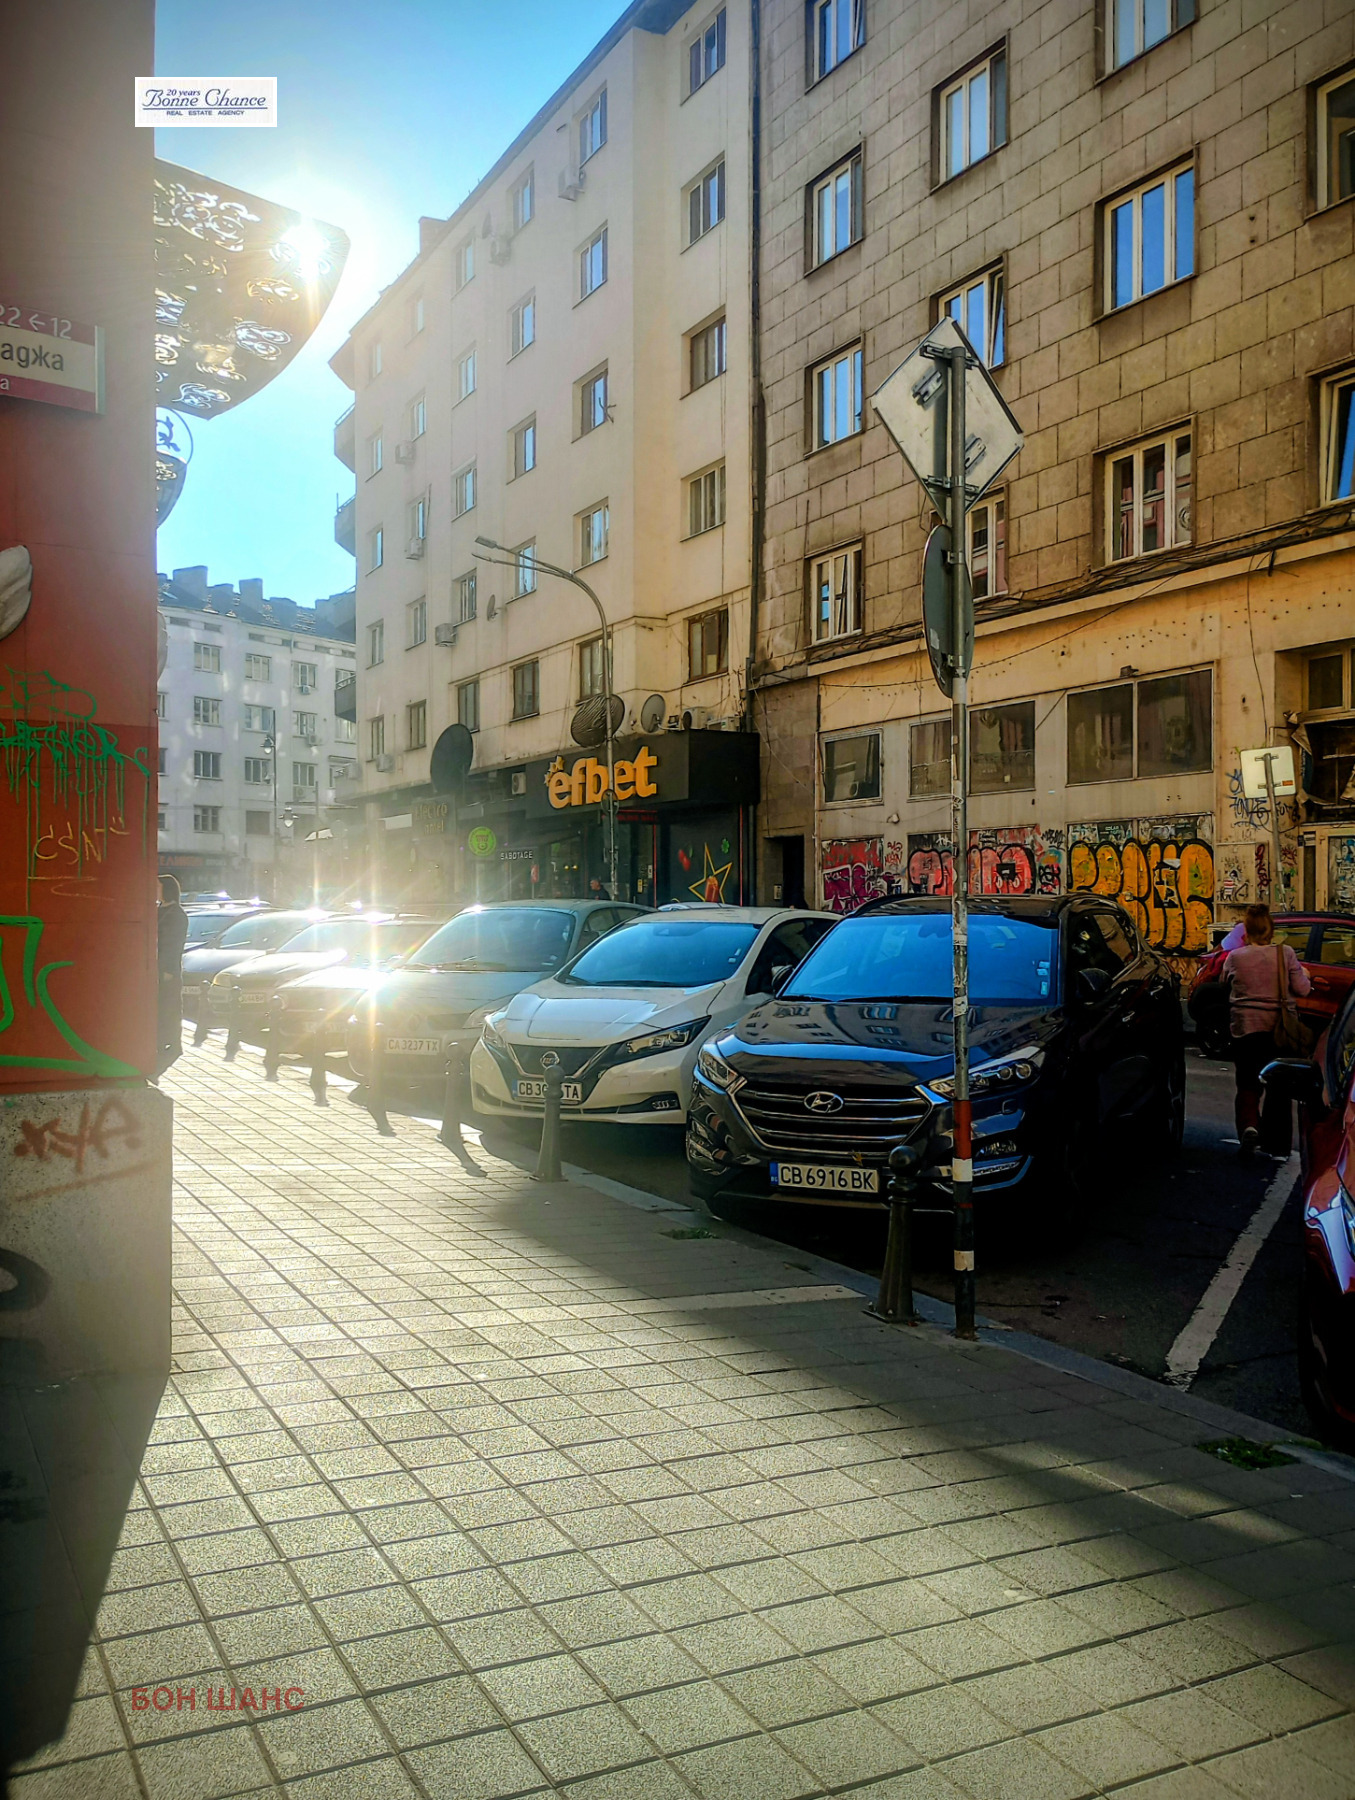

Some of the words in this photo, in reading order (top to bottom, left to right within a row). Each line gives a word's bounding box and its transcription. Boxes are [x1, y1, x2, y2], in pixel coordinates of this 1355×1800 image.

[50, 317, 72, 340] 12
[549, 746, 658, 809] efbet
[500, 850, 533, 861] SABOTAGE
